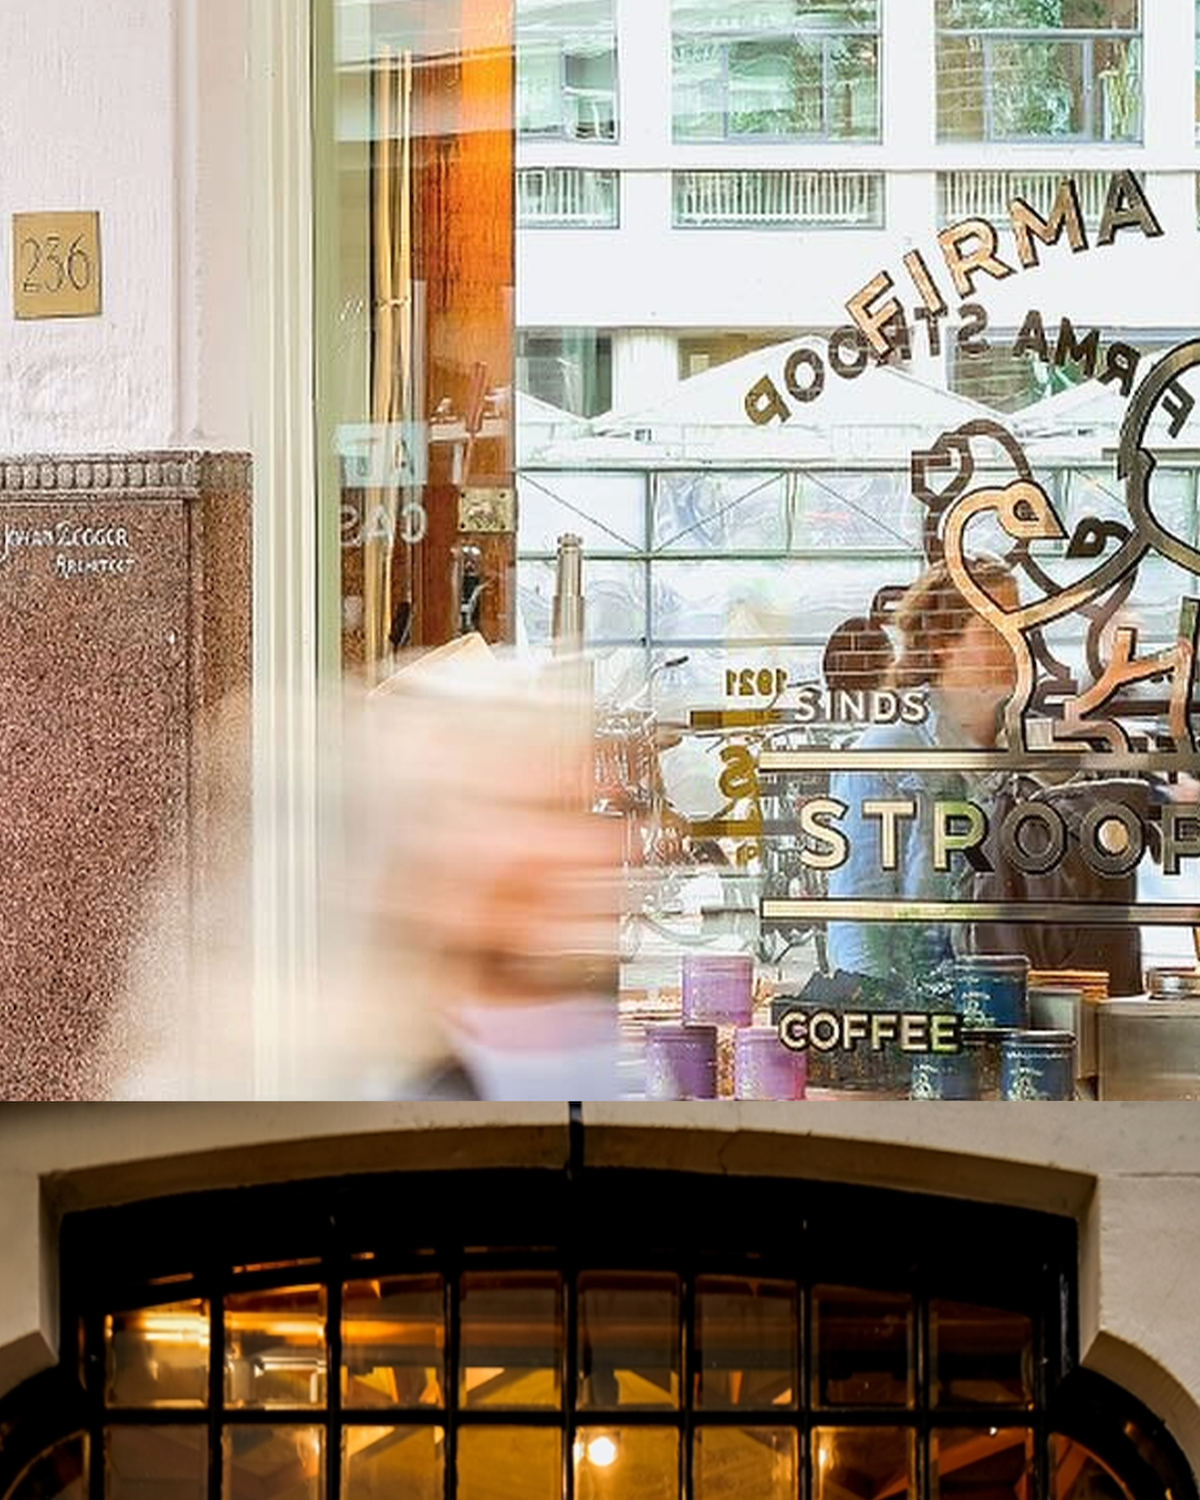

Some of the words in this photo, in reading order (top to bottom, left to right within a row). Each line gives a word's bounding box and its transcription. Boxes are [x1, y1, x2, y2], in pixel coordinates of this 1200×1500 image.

[21, 234, 92, 293] 236
[845, 170, 1165, 366] FIRMA
[792, 688, 928, 724] SINDS
[778, 1009, 961, 1053] COFFEE
